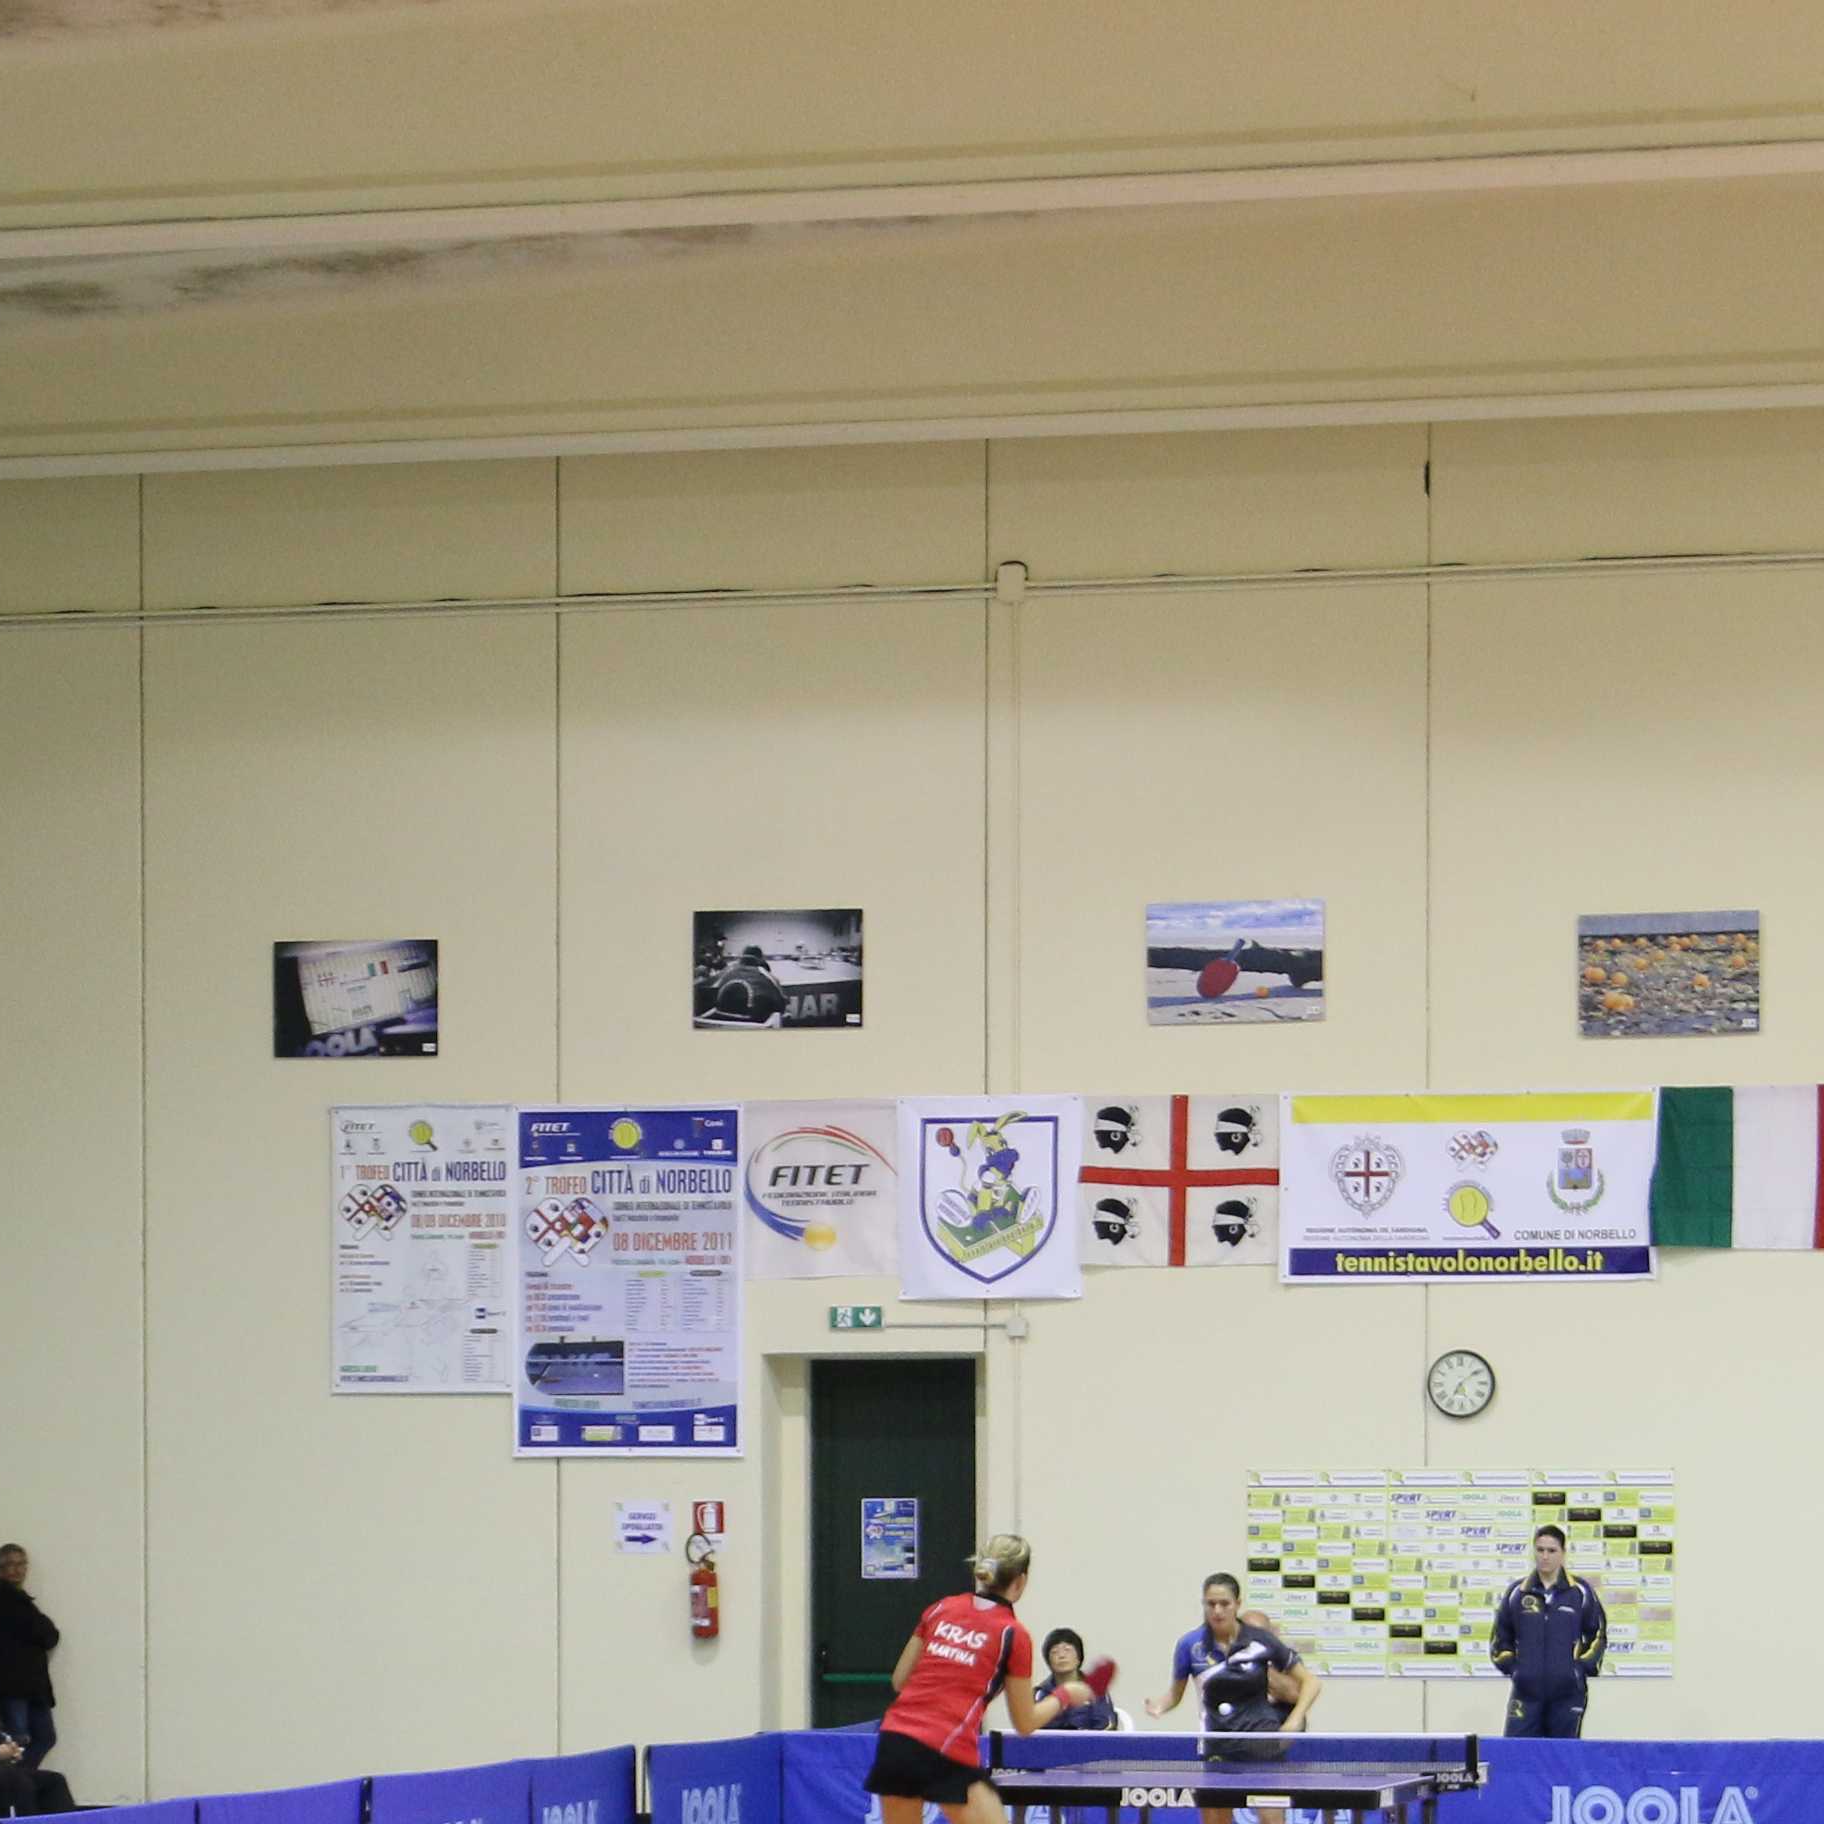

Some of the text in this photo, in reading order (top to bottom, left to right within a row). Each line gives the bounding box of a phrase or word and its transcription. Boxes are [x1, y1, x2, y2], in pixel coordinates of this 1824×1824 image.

[531, 1123, 570, 1132] FITET
[393, 1158, 427, 1182] CITTÀ
[446, 1161, 506, 1181] NORBELLO
[546, 1176, 586, 1194] TROFEO
[591, 1165, 633, 1194] CITTÀ
[640, 1176, 650, 1193] di
[656, 1169, 731, 1193] NORBELLO
[769, 1164, 870, 1186] FITET
[613, 1232, 732, 1250] 08 DICEMBRE 2011
[1514, 1229, 1636, 1241] COMUNE DI NORBELLO
[1336, 1248, 1604, 1273] tennistavolonorbello.it
[934, 1620, 988, 1649] KRAS
[927, 1642, 975, 1667] MARTINA
[1436, 1773, 1474, 1783] JOOLA
[1120, 1788, 1196, 1807] JOOLA
